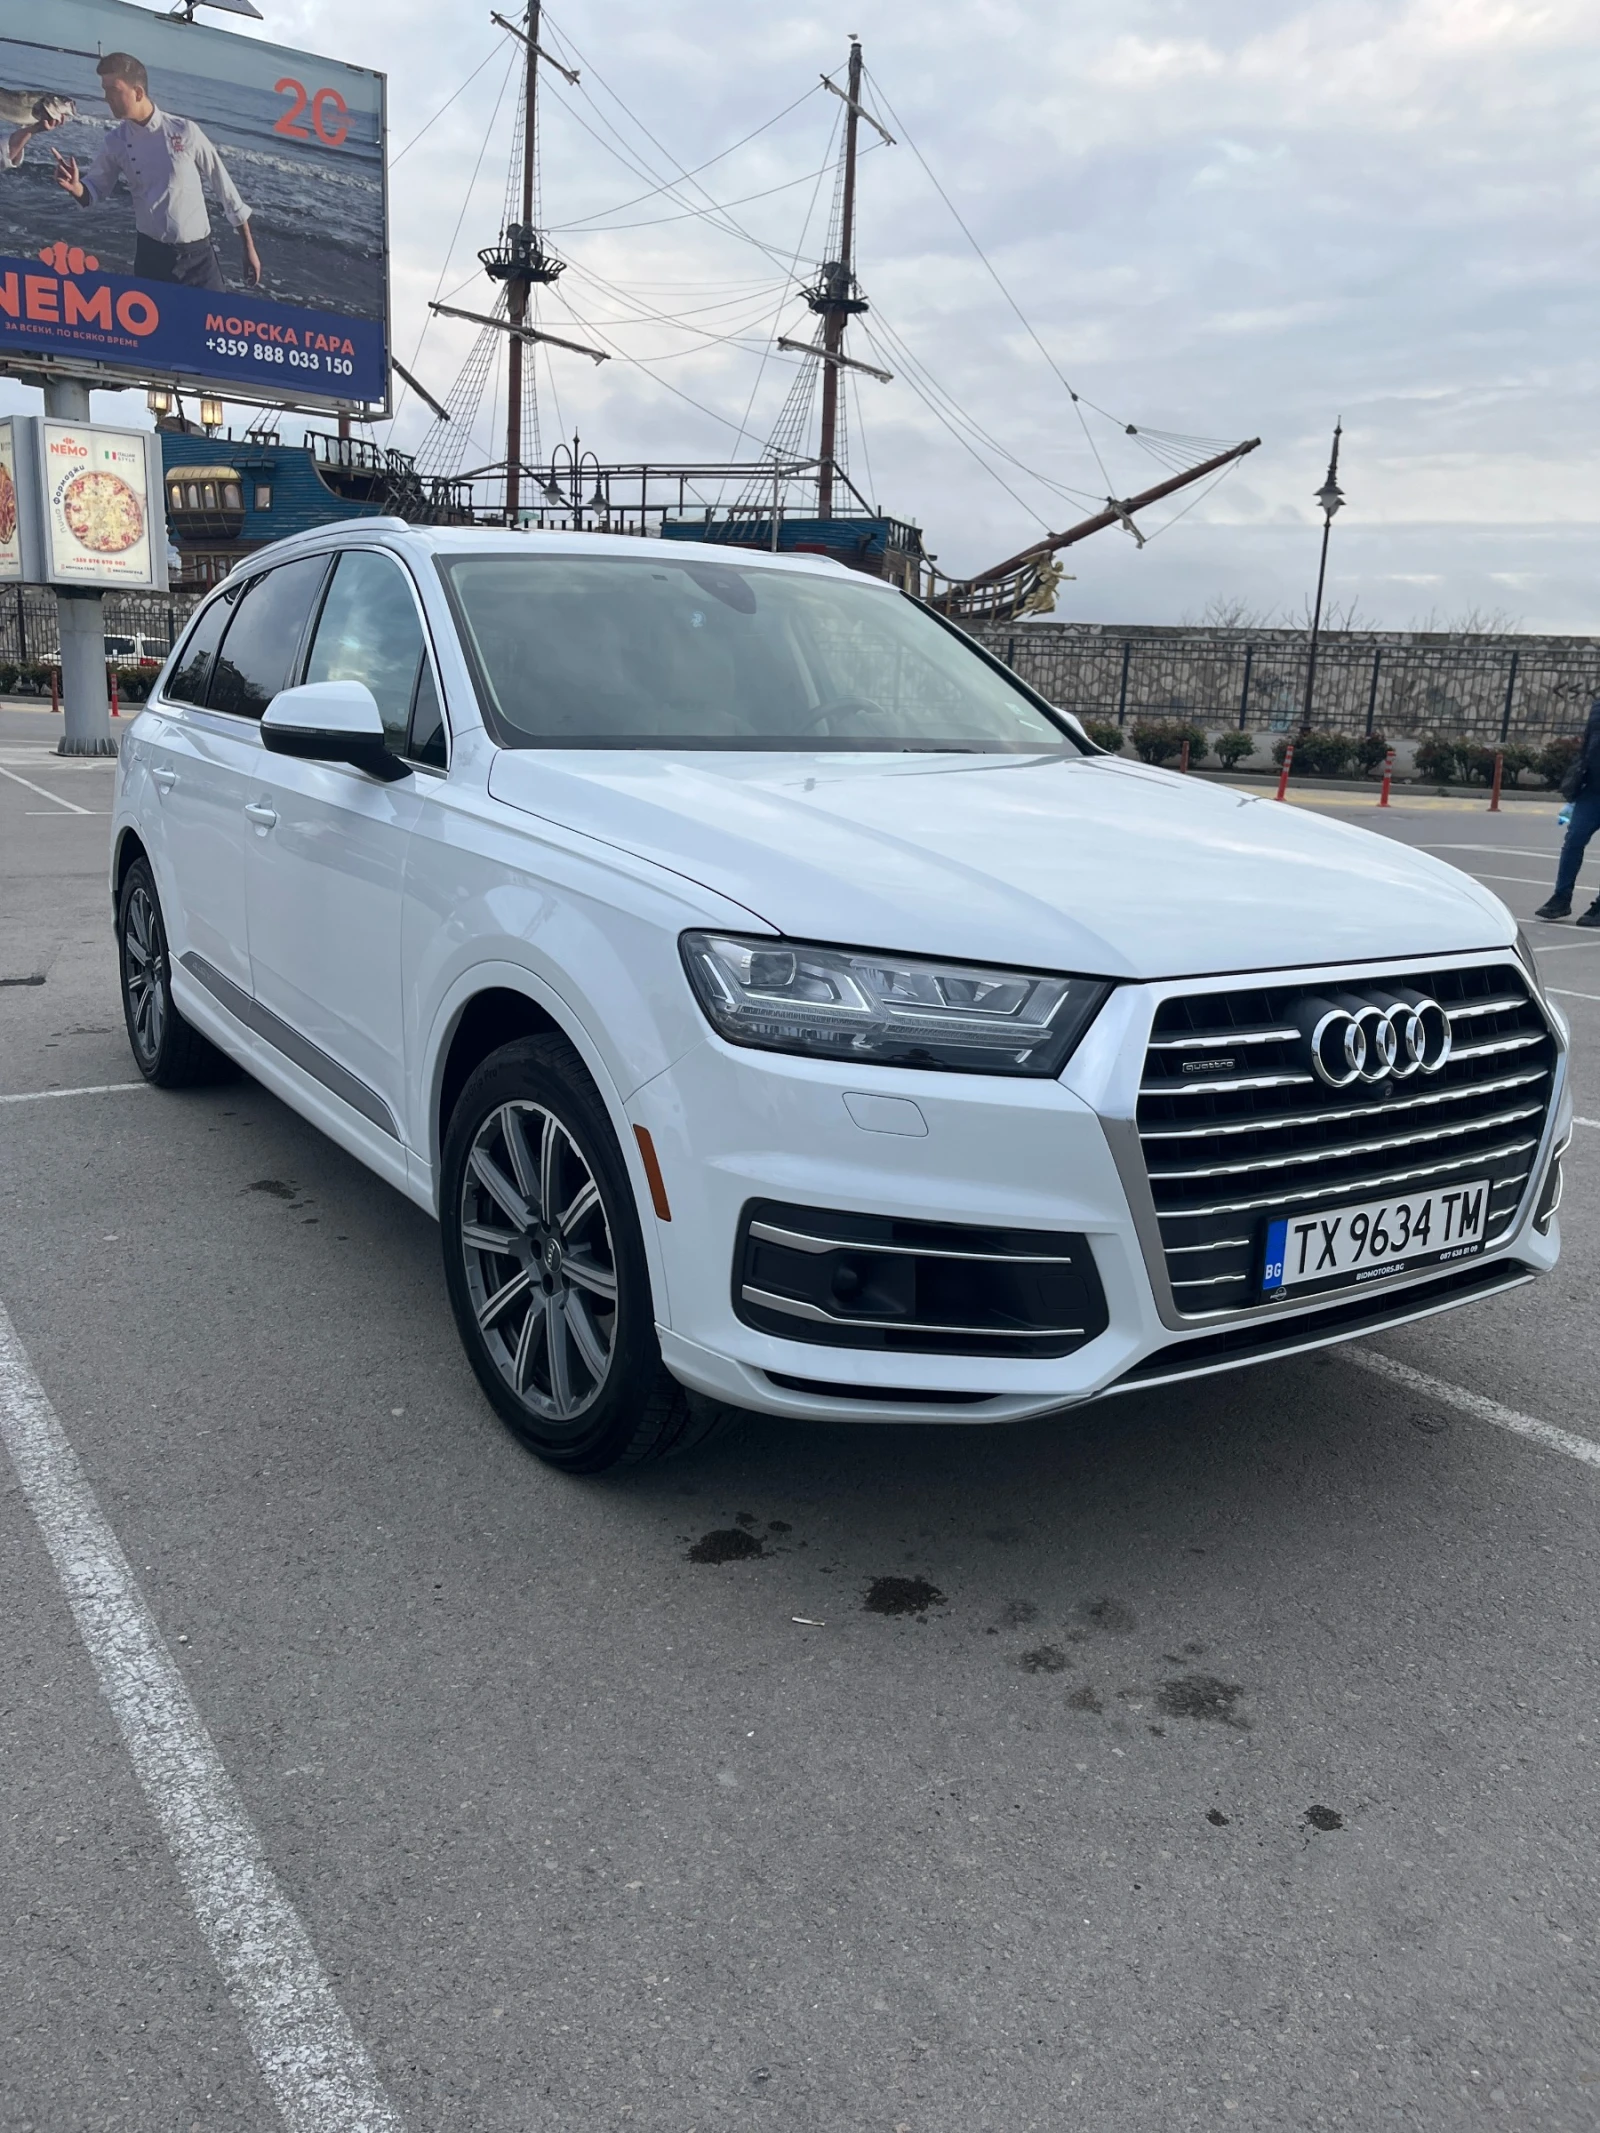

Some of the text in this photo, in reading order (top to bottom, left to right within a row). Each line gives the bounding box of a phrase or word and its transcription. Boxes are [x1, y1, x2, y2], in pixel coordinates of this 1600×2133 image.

[5, 321, 18, 331] ЗА
[56, 328, 71, 338] ПО
[73, 330, 105, 343] ВСЯКО
[107, 337, 139, 348] ВРЕМЕ
[205, 313, 355, 356] МОРСКА ГАРА
[206, 337, 353, 376] +359 888 033 150
[50, 443, 88, 457] NEMO
[1185, 1060, 1234, 1072] quattro
[1294, 1188, 1483, 1275] TX 9634 TM
[1265, 1262, 1282, 1280] BG
[1355, 1263, 1405, 1281] BIDMOTORS.BG
